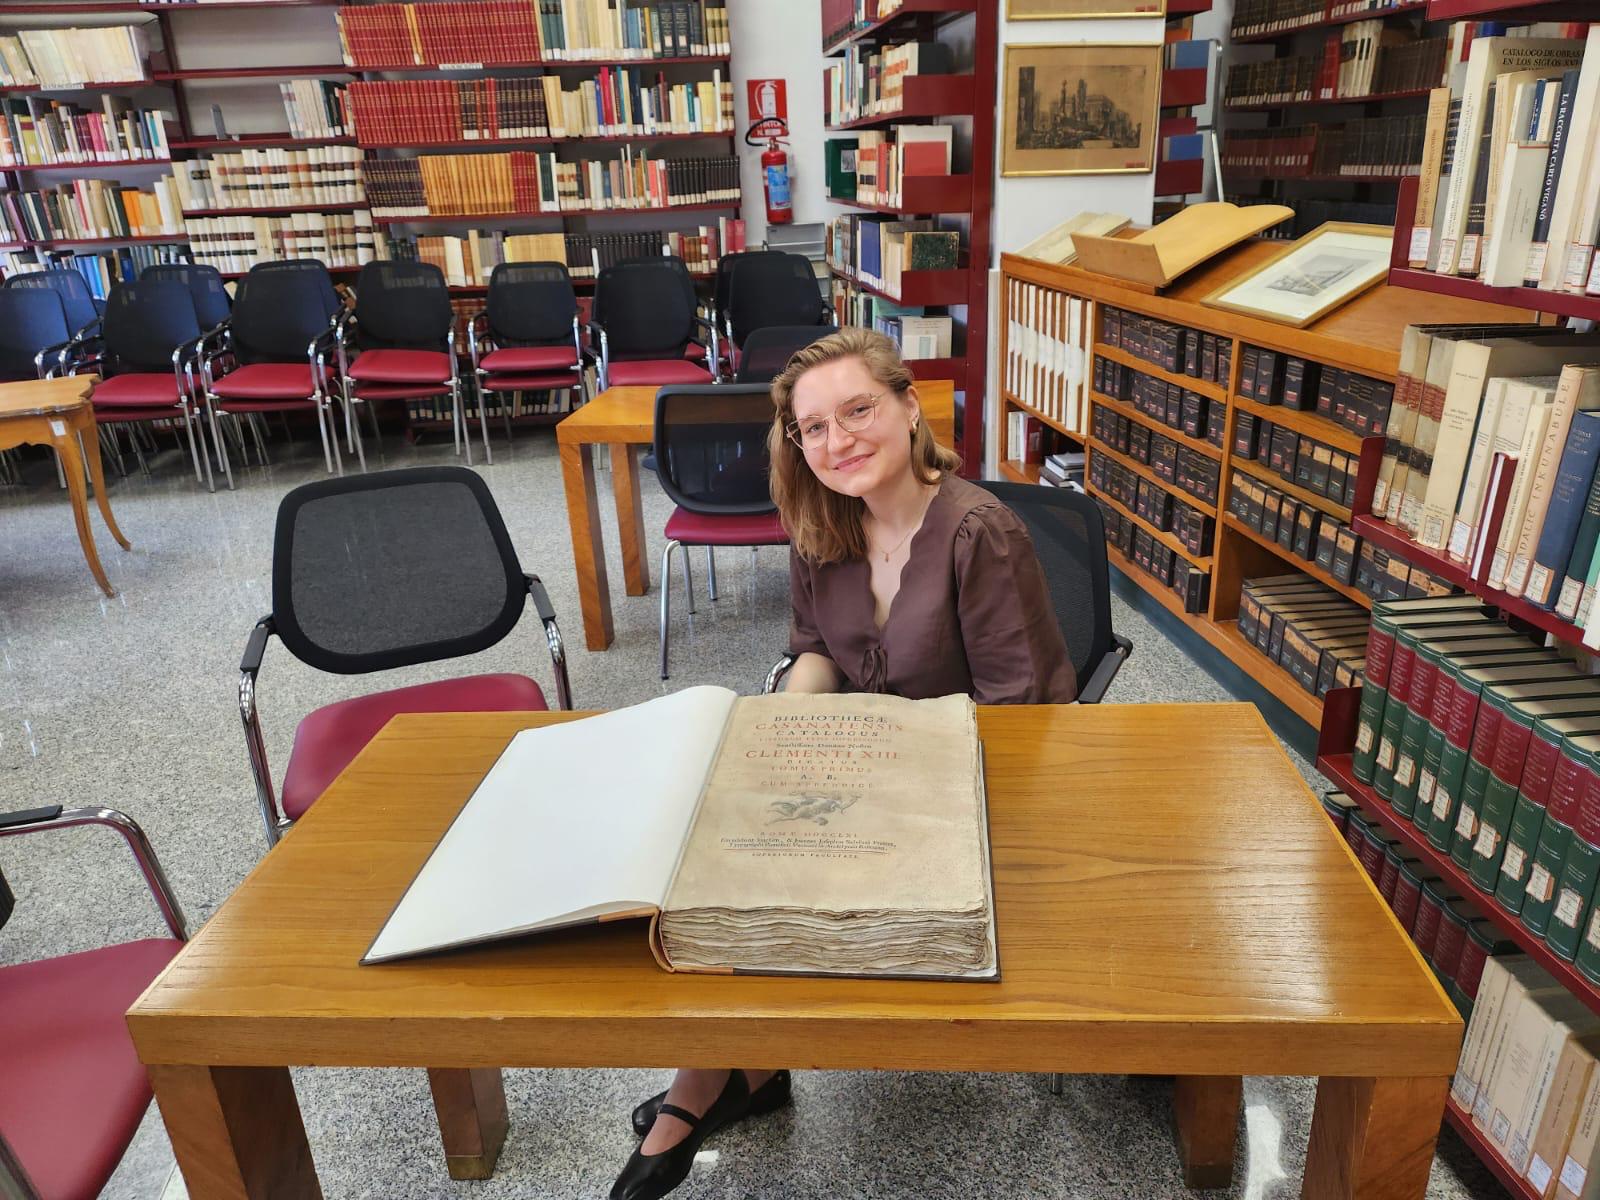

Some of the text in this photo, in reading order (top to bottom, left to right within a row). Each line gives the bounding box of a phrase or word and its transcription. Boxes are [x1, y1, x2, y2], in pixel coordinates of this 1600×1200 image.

[1502, 48, 1543, 57] CATALOGO
[1543, 49, 1554, 57] DE
[1555, 49, 1581, 57] OBRAS
[1516, 58, 1531, 66] LOS
[1533, 58, 1561, 67] SIGLOS
[1560, 93, 1570, 106] LA
[1551, 106, 1567, 157] RACCOLTA
[1545, 157, 1557, 186] CARLO
[755, 722, 903, 731] CASANATENSIS
[745, 750, 902, 759] CLEMENTI XIII
